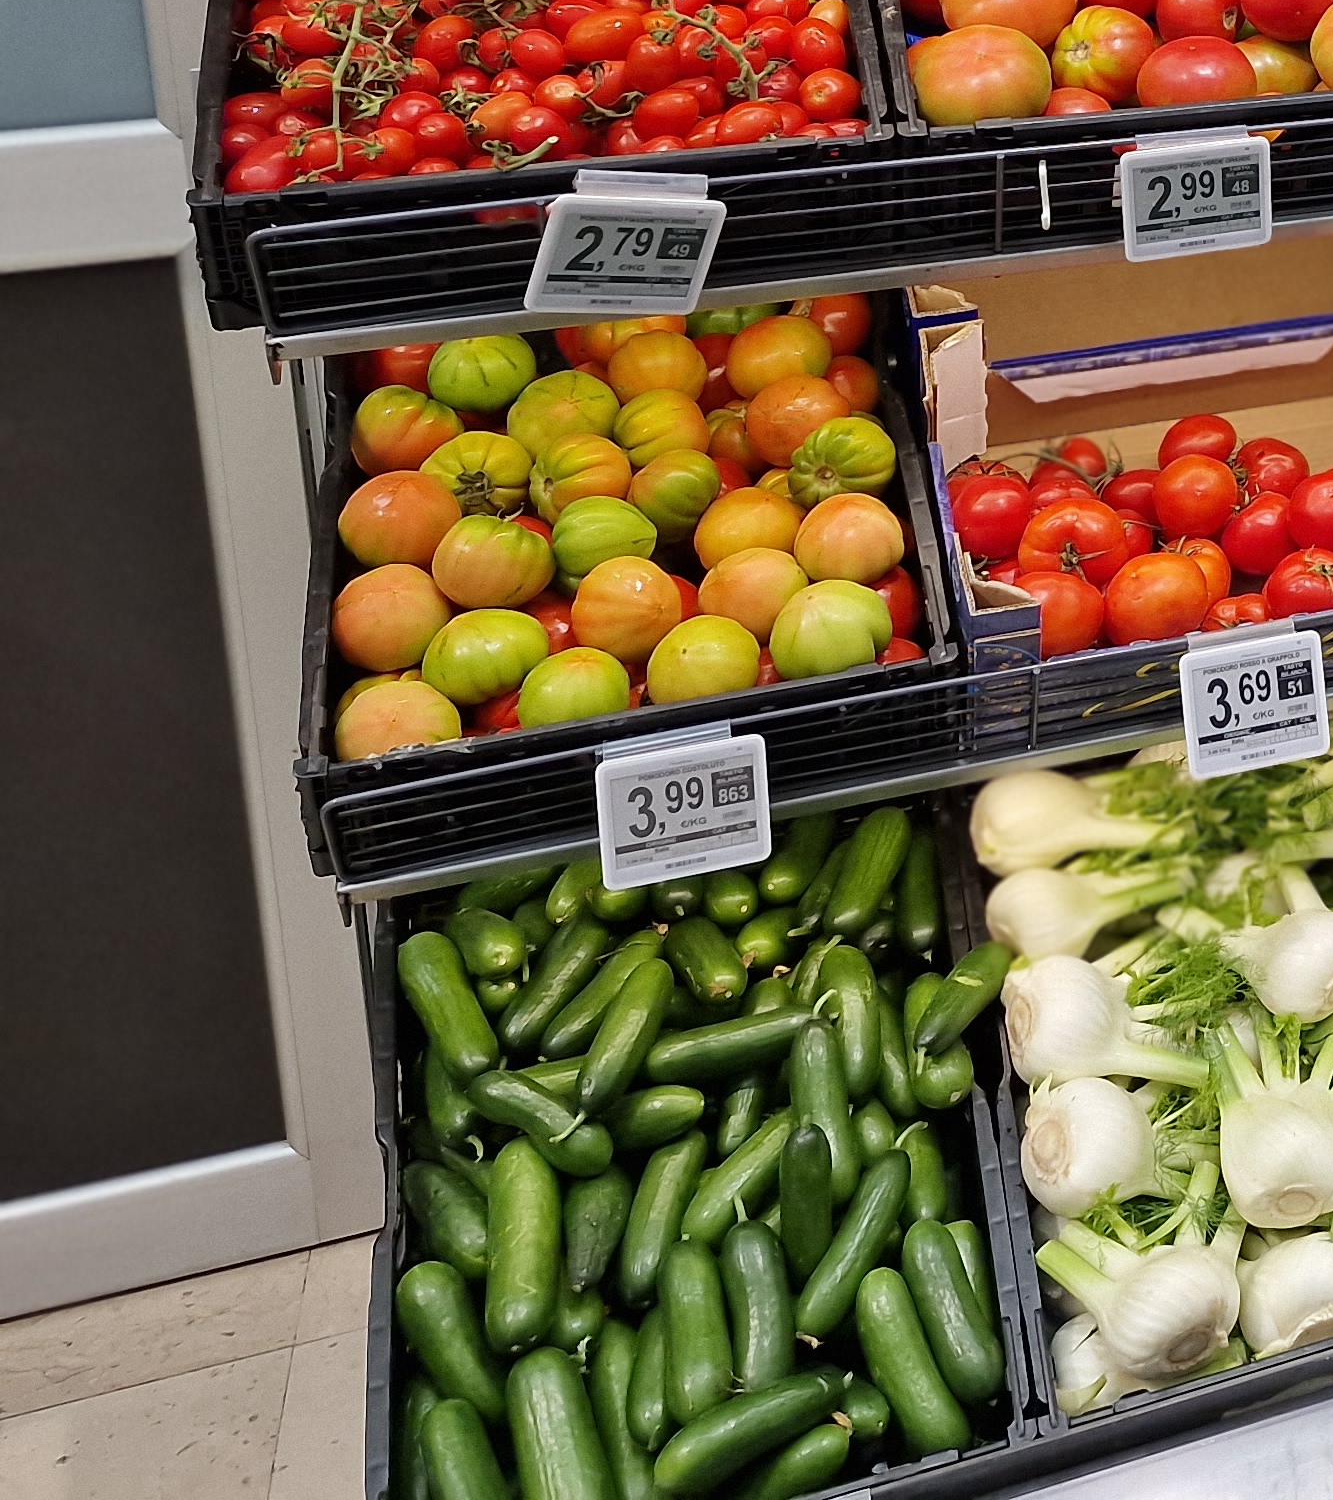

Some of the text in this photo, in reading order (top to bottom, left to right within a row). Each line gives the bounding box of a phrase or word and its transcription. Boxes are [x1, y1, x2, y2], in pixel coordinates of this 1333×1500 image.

[1148, 170, 1215, 220] 2,99
[1232, 180, 1250, 193] 48
[565, 226, 653, 273] 2,79
[667, 244, 690, 258] 49
[1287, 679, 1304, 696] 51
[1207, 670, 1271, 729] 3,69
[1252, 709, 1275, 720] €/KG
[718, 784, 749, 804] 863
[627, 777, 704, 838] 3,99
[680, 816, 707, 828] €/KG
